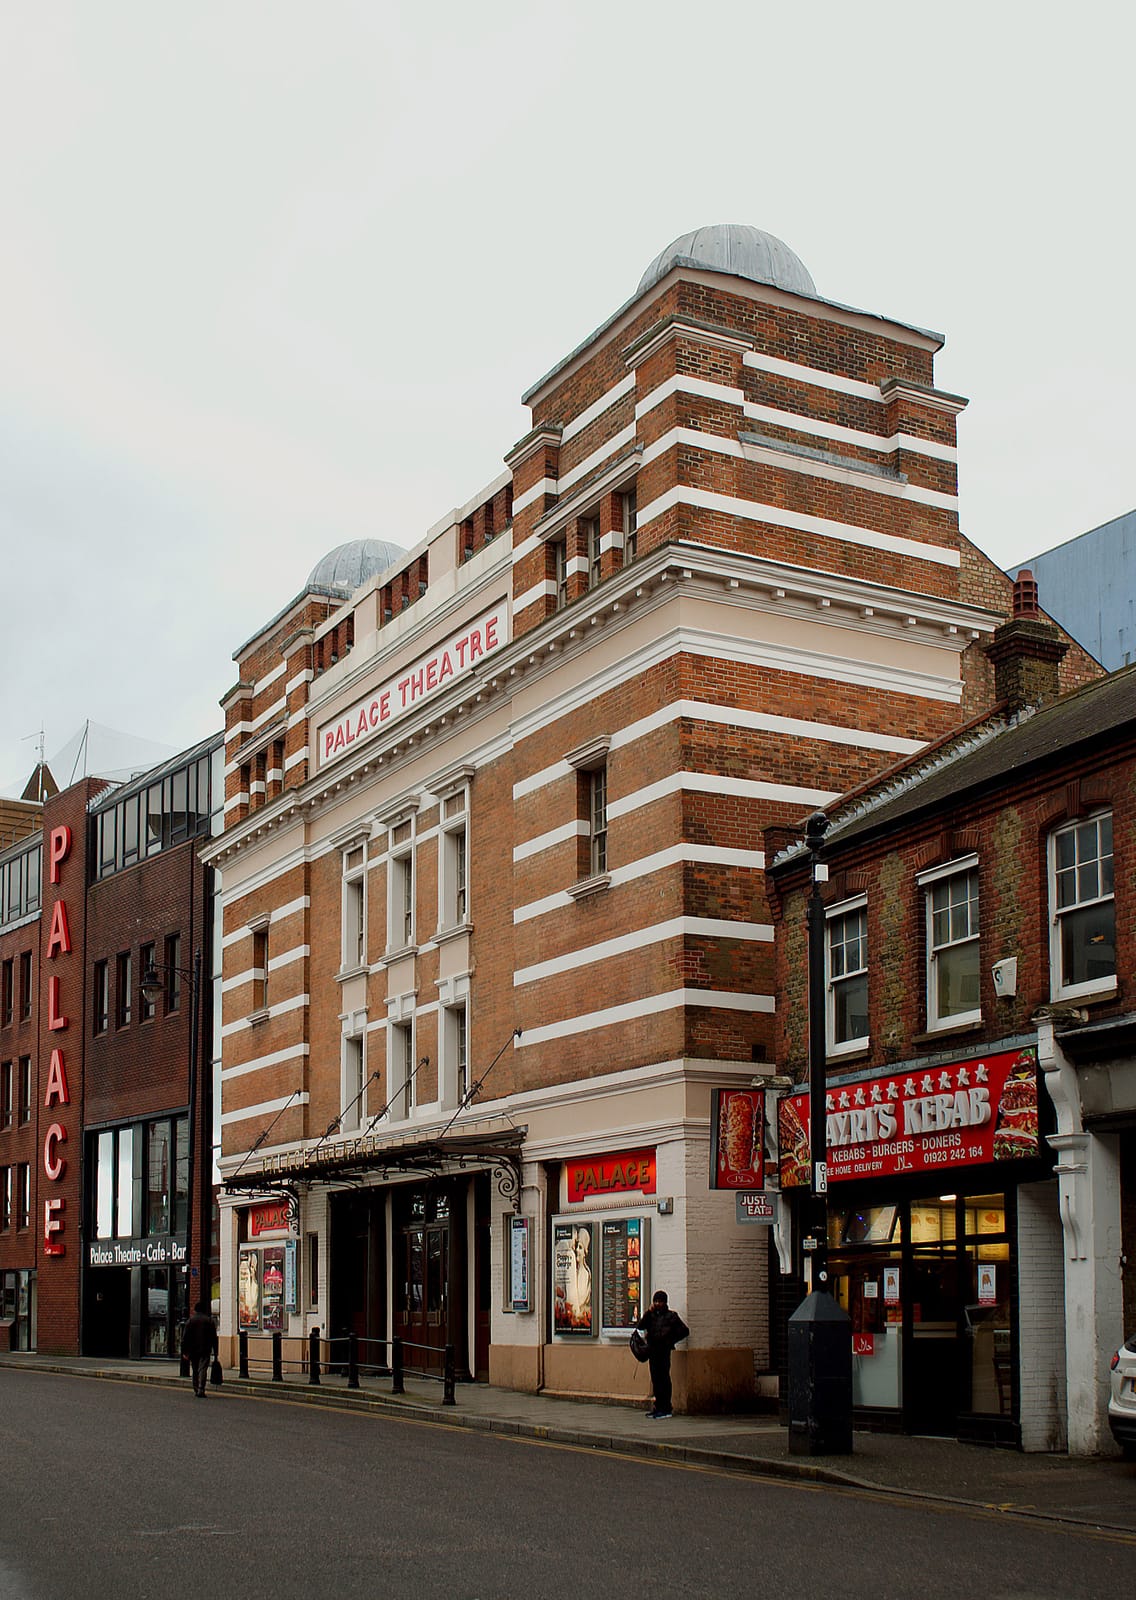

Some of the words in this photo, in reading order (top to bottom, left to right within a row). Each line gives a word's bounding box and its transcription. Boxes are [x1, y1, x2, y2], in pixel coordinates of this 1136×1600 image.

[325, 691, 391, 758] PALACE
[398, 616, 499, 707] THEATRE
[44, 824, 72, 1257] PALACE
[808, 1103, 897, 1147] AYRI'S
[903, 1087, 991, 1136] KEBAB
[832, 1148, 866, 1163] KEBABS
[872, 1139, 915, 1158] BURGERS
[922, 1133, 961, 1150] DONERS
[923, 1150, 948, 1164] 01923
[950, 1148, 966, 1160] 242
[969, 1145, 983, 1158] 164
[262, 1149, 309, 1176] PALACE
[574, 1159, 651, 1192] PALACE
[835, 1164, 852, 1176] HOME
[854, 1160, 883, 1173] DELIVERY
[741, 1195, 766, 1205] JUST
[748, 1205, 766, 1215] EAT
[90, 1245, 113, 1265] Palace
[114, 1244, 141, 1263] Theatre
[146, 1241, 165, 1262] Cafe
[171, 1242, 187, 1260] Bar
